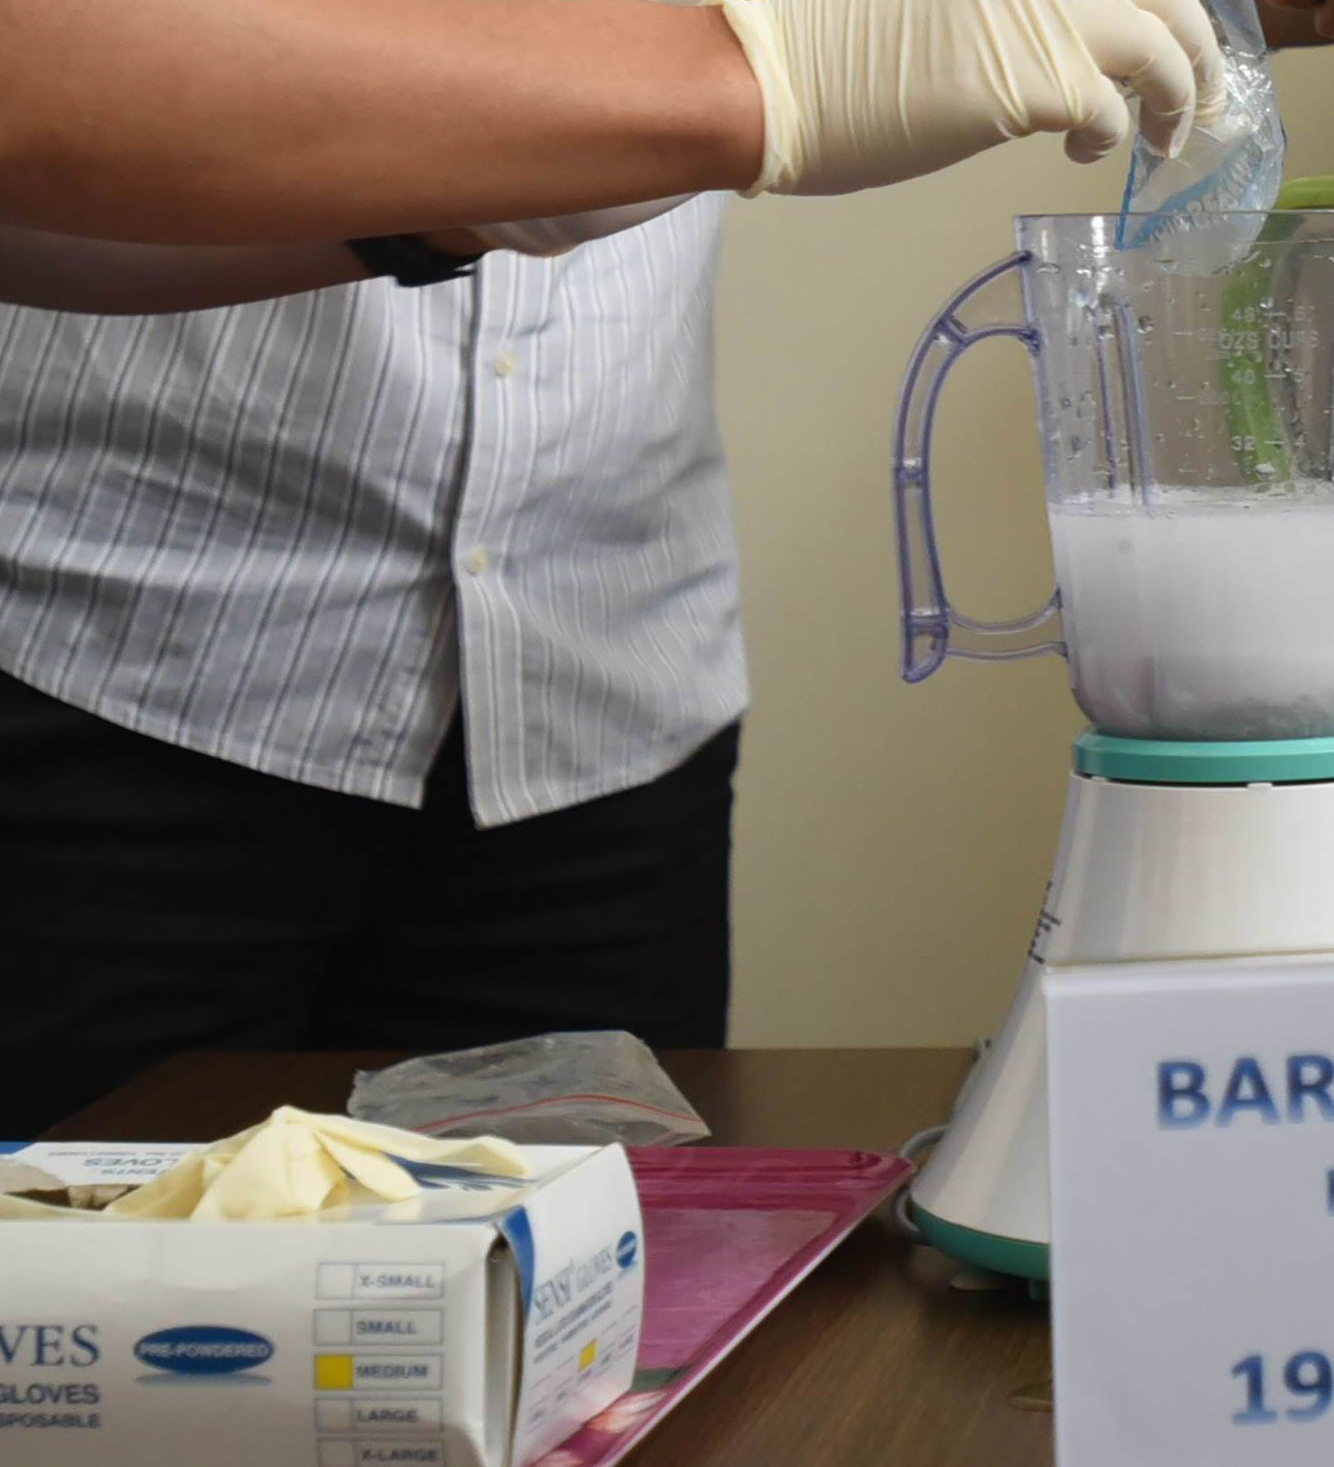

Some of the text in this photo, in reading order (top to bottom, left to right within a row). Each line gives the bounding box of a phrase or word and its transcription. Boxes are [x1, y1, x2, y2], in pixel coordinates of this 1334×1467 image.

[359, 1274, 435, 1289] X-SMALL
[356, 1320, 418, 1335] SMALL
[356, 1364, 429, 1379] MEDIUM
[357, 1408, 418, 1423] LARGE
[361, 1447, 439, 1463] X-LARGE
